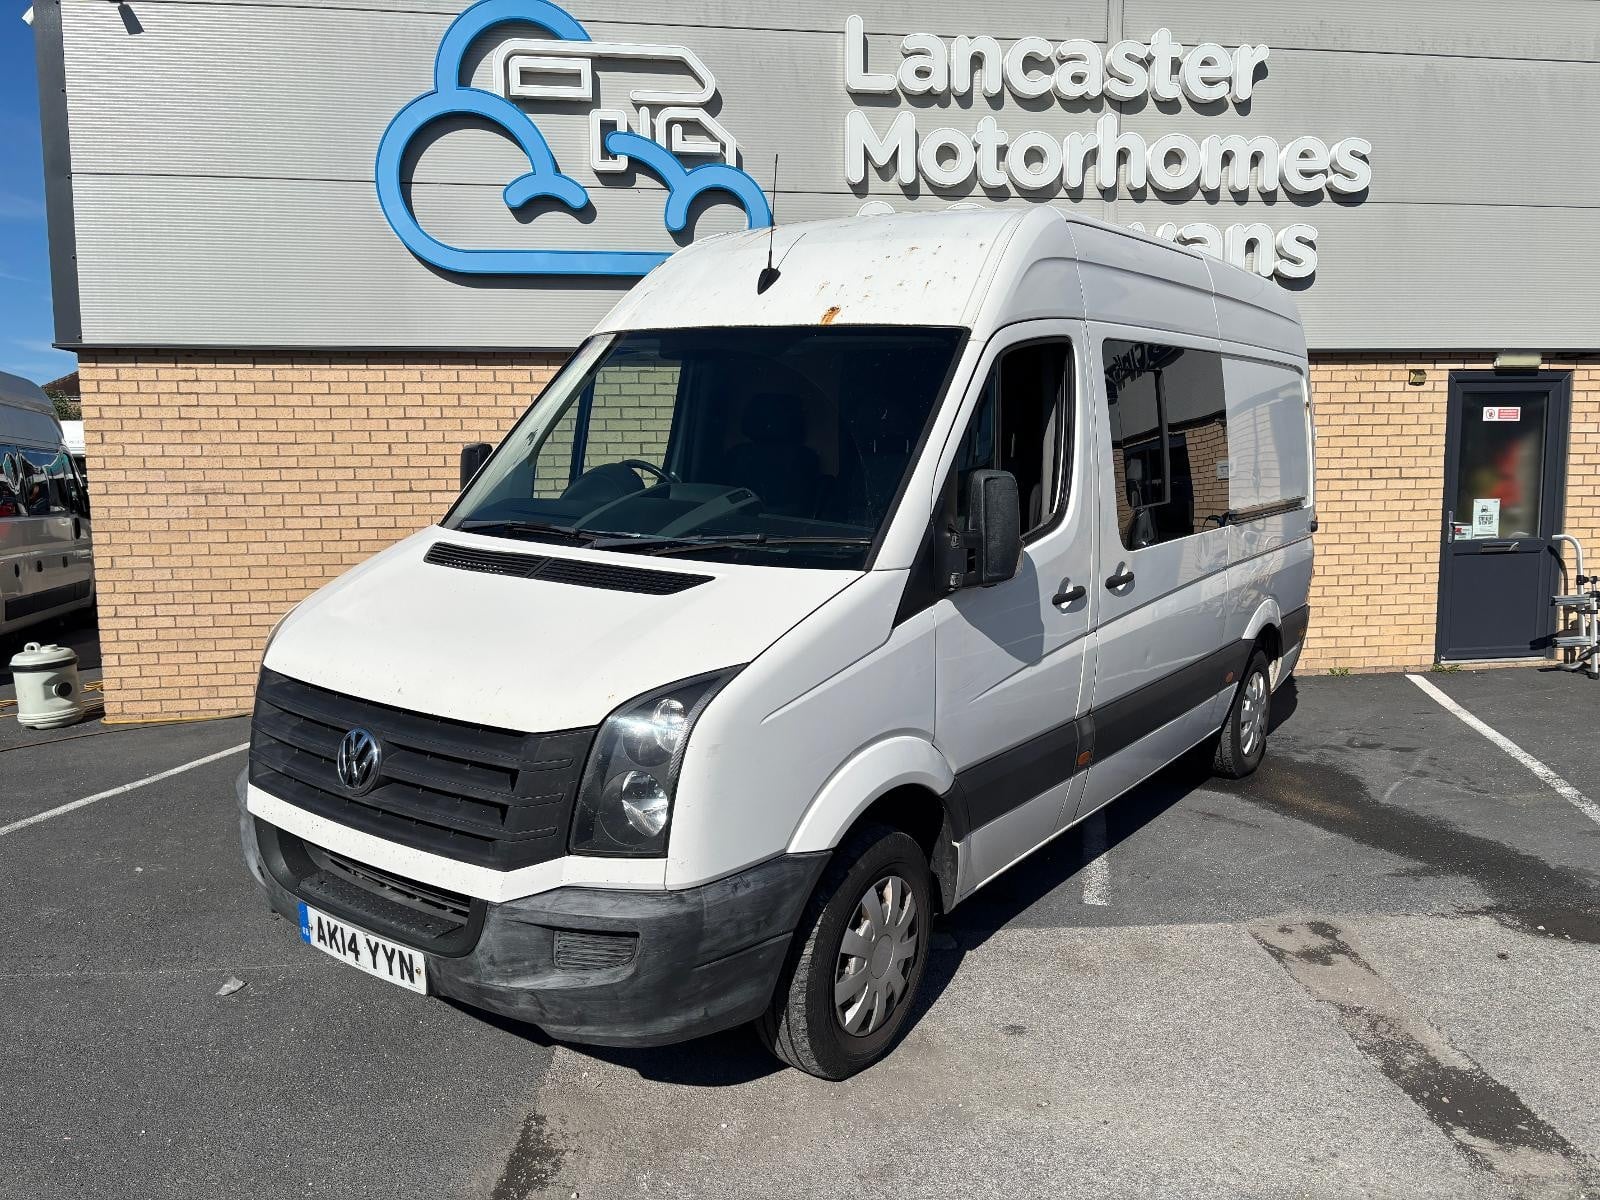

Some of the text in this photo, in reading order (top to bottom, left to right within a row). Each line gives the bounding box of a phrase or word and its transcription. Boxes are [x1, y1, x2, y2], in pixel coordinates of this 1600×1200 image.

[845, 14, 1269, 104] Lancaster
[845, 110, 1372, 195] Motorhomes
[317, 915, 415, 984] AK14 YYN
